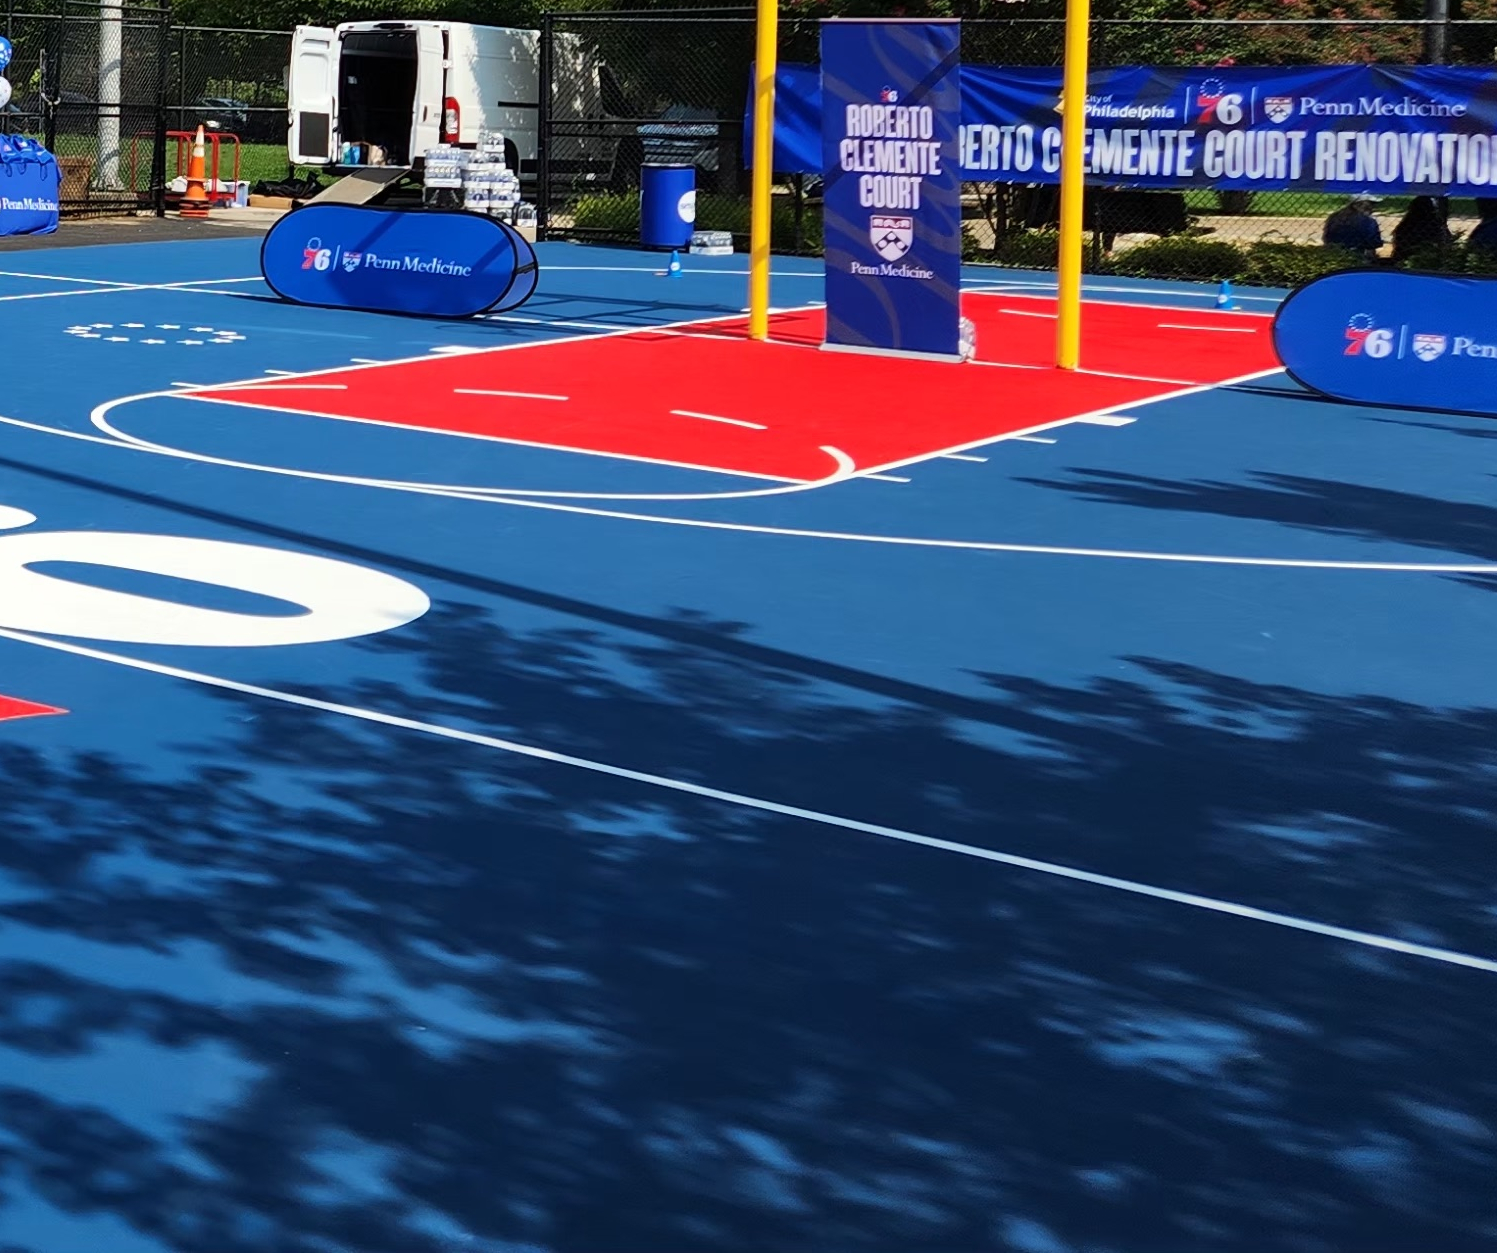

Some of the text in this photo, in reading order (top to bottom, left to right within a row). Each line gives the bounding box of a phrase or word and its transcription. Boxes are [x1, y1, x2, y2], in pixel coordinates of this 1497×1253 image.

[1084, 104, 1176, 121] Philadelphia
[1198, 93, 1243, 125] 76
[1300, 97, 1467, 118] Penn Medicine
[846, 104, 933, 139] ROBERTO
[840, 139, 943, 175] CLEMENTE
[1041, 126, 1196, 177] CEMENTE
[1203, 130, 1306, 179] COURT
[2, 197, 23, 210] Penn
[859, 174, 923, 210] COURT
[301, 249, 332, 271] 76
[364, 253, 472, 277] Penn Medicine
[851, 261, 934, 280] Penn Medicine
[1343, 328, 1394, 359] 76
